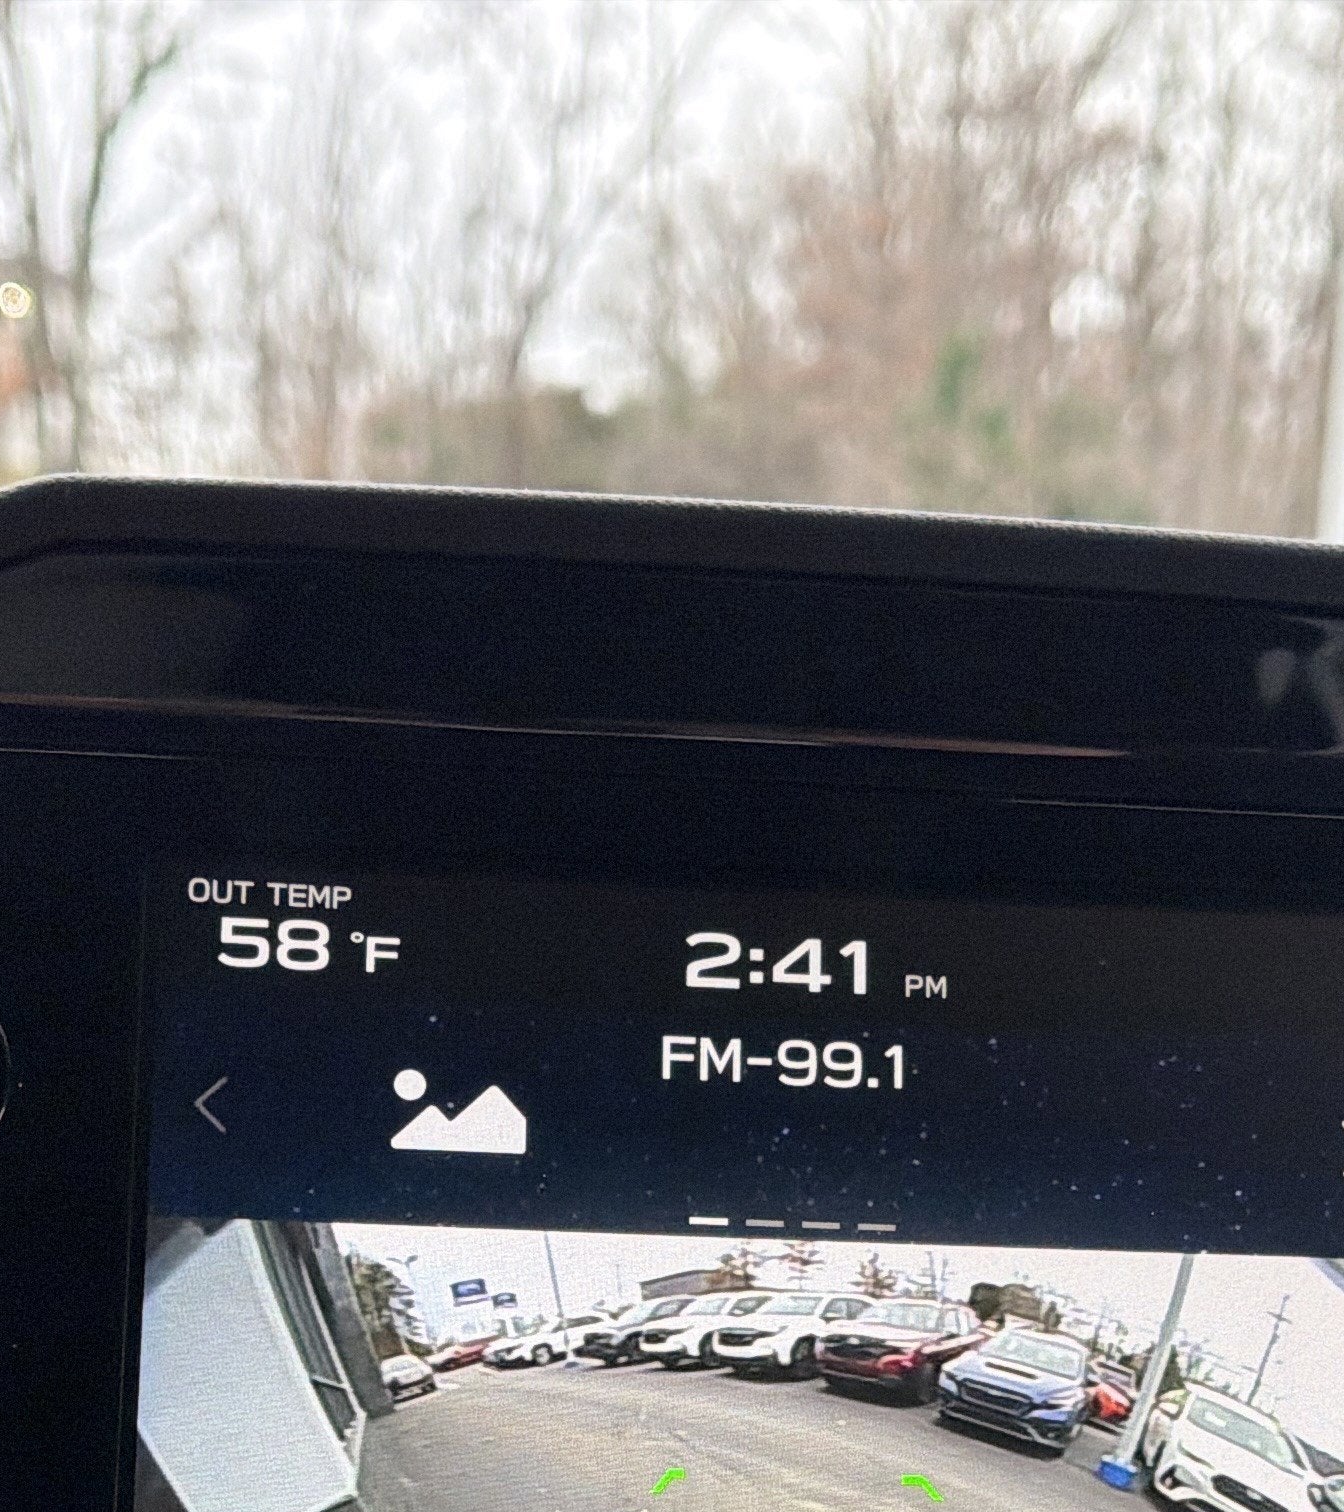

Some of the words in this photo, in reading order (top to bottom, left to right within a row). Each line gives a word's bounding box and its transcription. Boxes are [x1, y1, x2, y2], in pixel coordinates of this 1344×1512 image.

[187, 876, 256, 906] OUT
[266, 881, 353, 912] TEMP
[216, 917, 332, 972] 58
[684, 930, 870, 997] 2:41
[903, 972, 949, 1000] PM
[660, 1033, 909, 1091] FM-99.1
